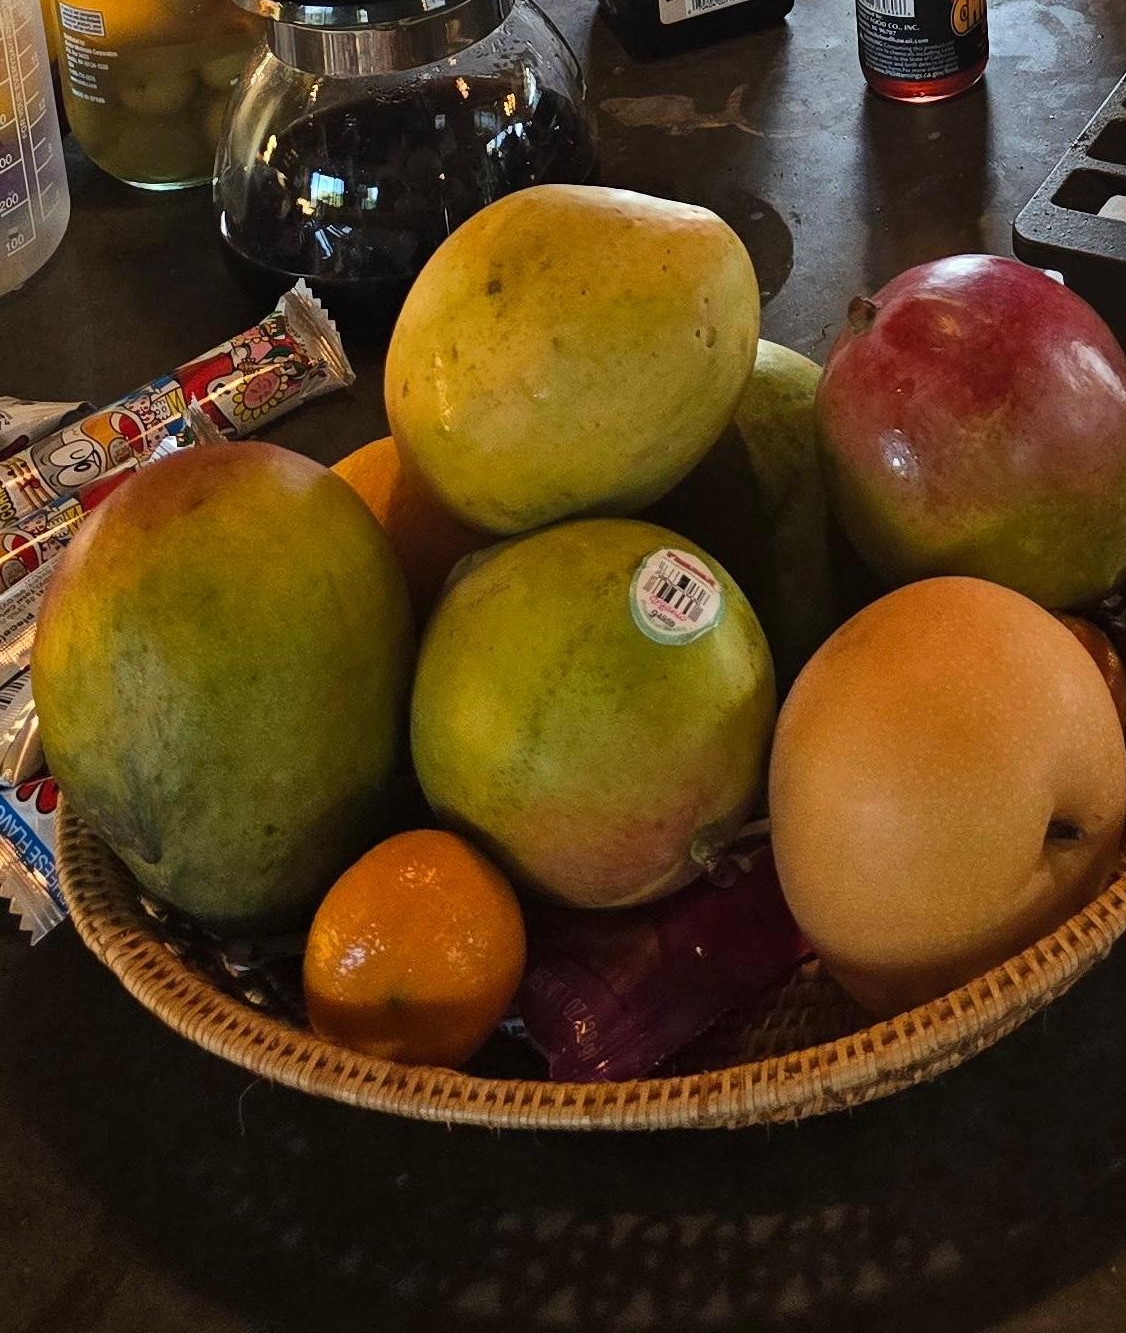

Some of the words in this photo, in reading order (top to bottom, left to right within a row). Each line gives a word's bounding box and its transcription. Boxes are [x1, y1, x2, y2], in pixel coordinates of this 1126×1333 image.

[19, 118, 28, 139] FOR
[0, 153, 12, 169] 00
[0, 193, 19, 211] 200
[6, 233, 25, 252] 100
[0, 804, 34, 853] FLAVO
